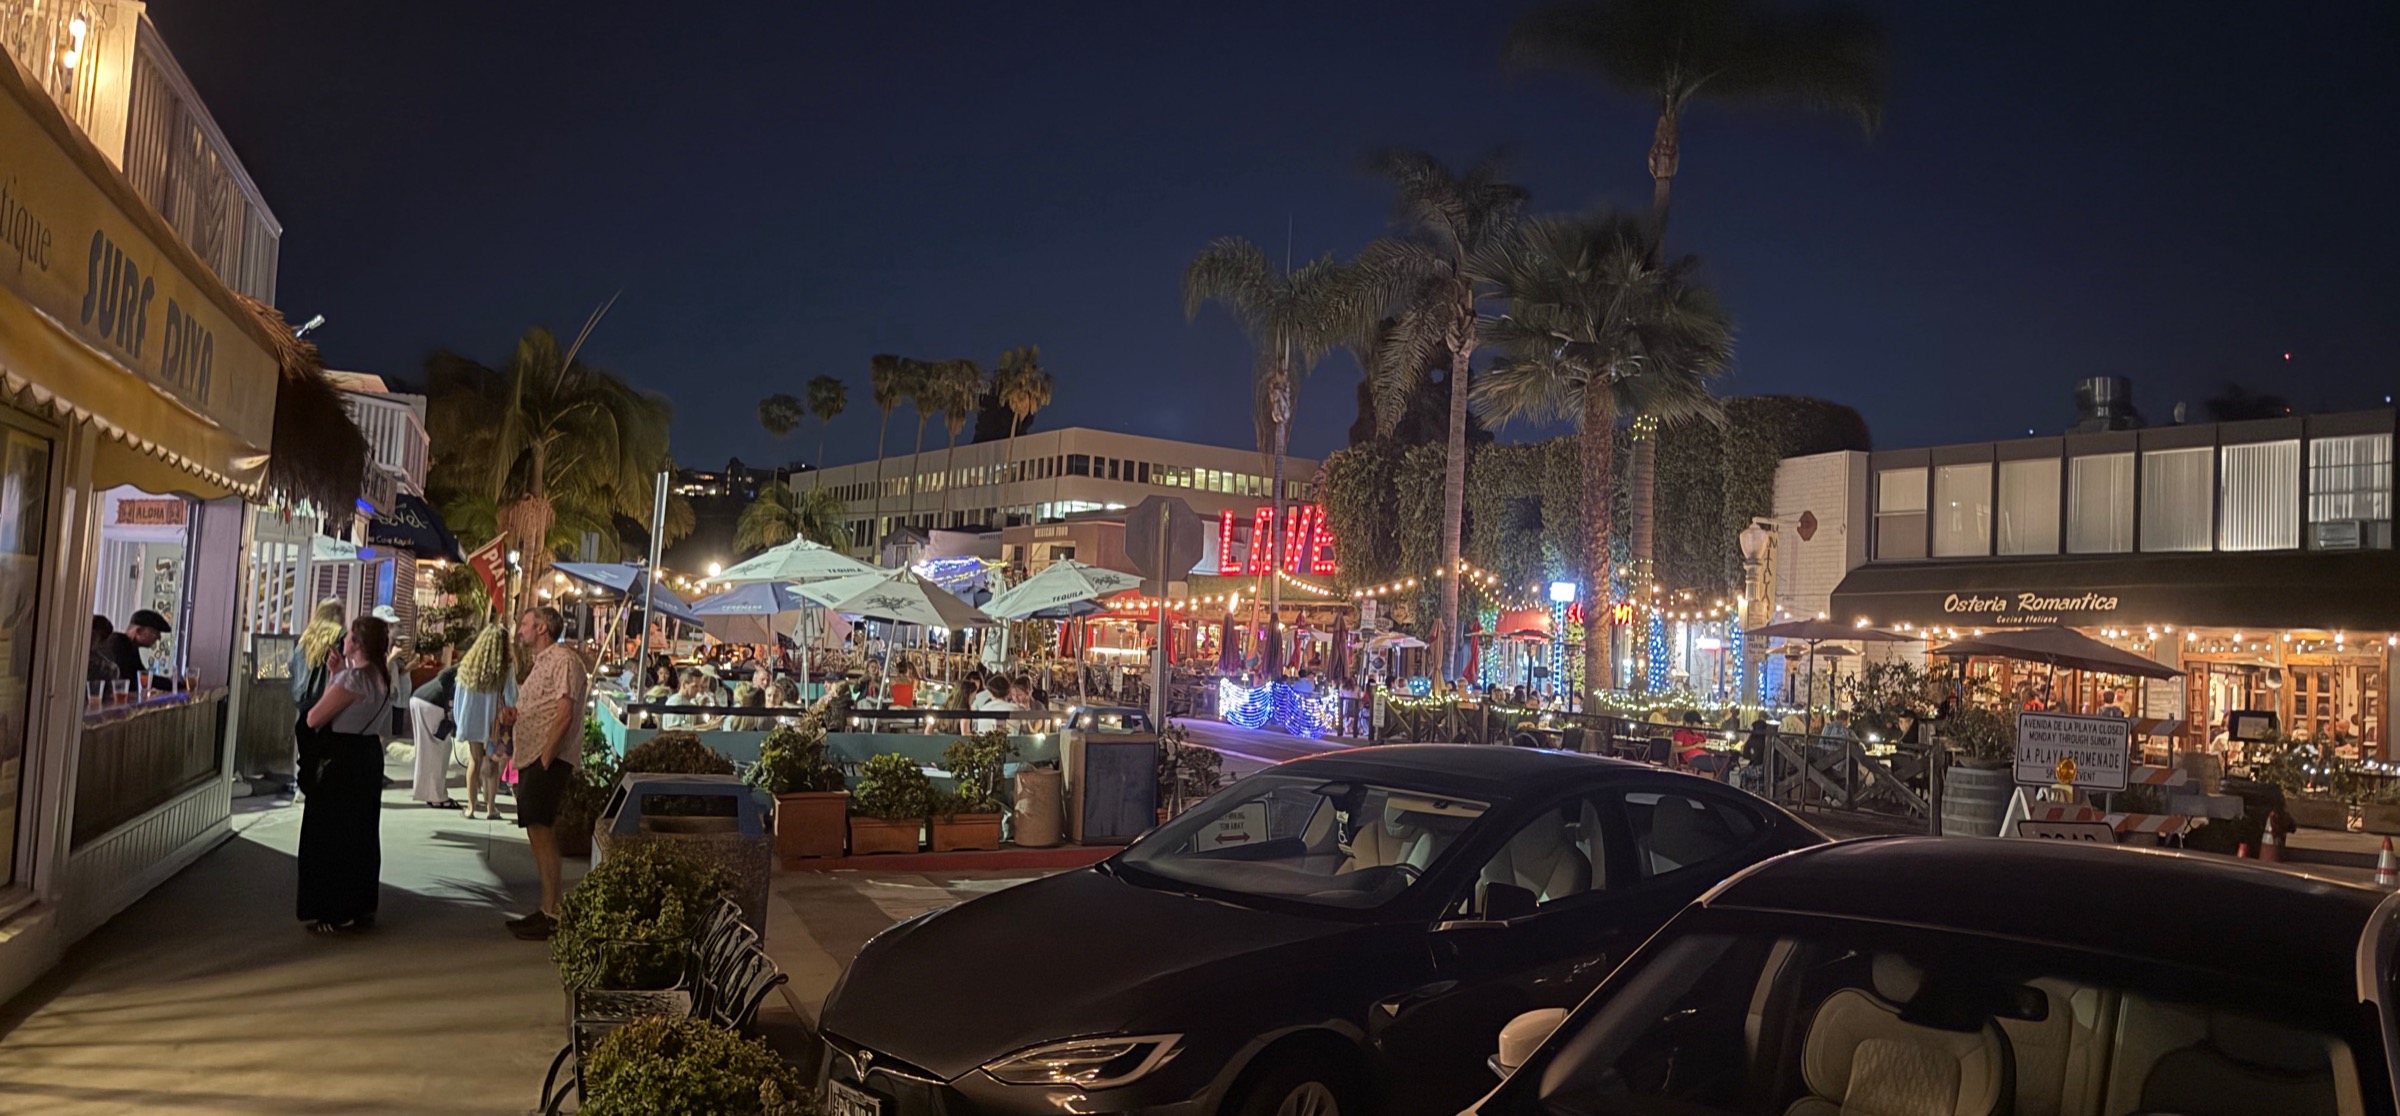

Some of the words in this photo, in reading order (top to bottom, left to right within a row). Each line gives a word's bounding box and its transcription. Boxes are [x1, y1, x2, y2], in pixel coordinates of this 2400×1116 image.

[80, 228, 156, 360] SURF
[160, 296, 214, 406] DIVA
[135, 506, 165, 520] ALOHA
[1219, 504, 1336, 576] LOVE
[827, 566, 864, 574] TEQUILA
[1052, 590, 1084, 603] TEQUILA
[1944, 593, 2007, 613] Osteria
[2016, 592, 2118, 613] Romantica
[2025, 614, 2058, 624] Italiana
[2023, 718, 2053, 730] AVENIDA
[2053, 720, 2062, 731] DE
[2063, 721, 2073, 732] LA
[2074, 721, 2098, 734] PLAYA
[2099, 724, 2125, 736] CLOSED
[2029, 730, 2057, 743] MONDAY
[2059, 732, 2089, 745] THROUGH
[2090, 735, 2117, 748] SUNDAY
[2020, 747, 2031, 763] LA
